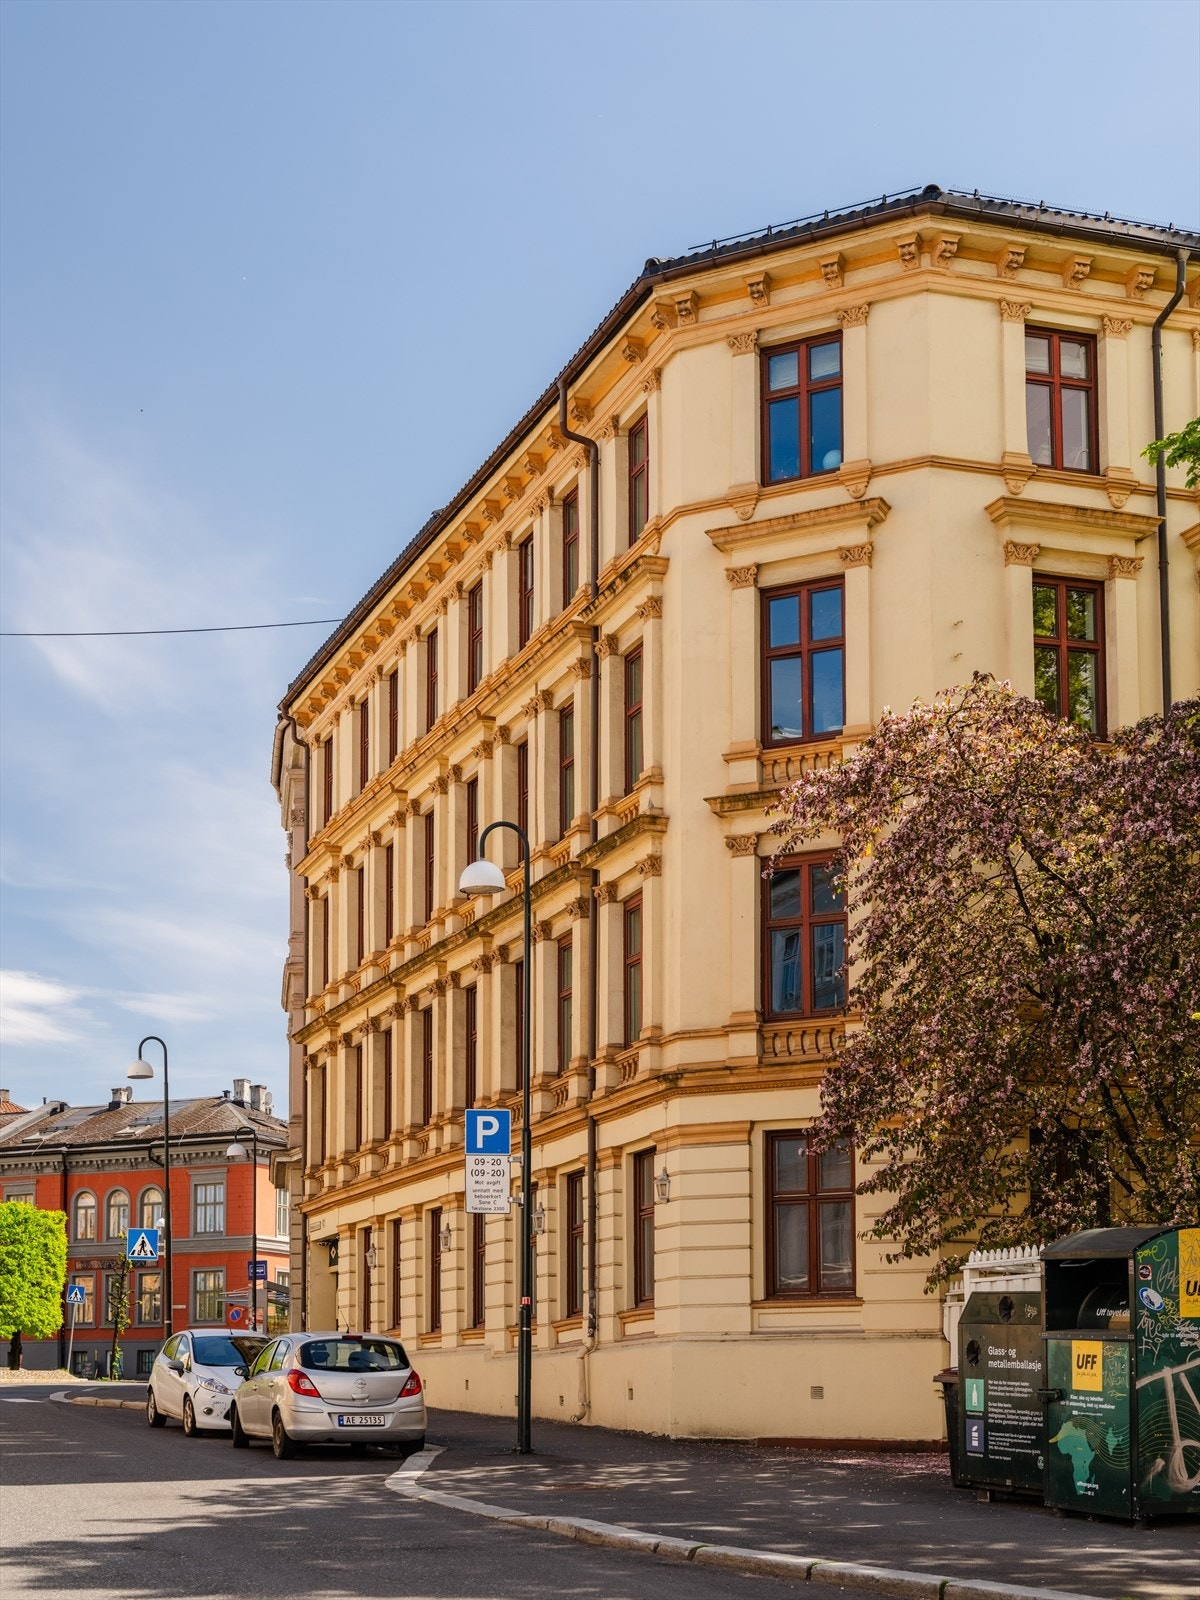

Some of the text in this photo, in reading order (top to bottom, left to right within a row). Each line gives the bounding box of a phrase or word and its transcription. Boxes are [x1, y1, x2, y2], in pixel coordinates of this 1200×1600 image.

[477, 1116, 499, 1148] P
[988, 1346, 1017, 1359] Glass- og
[988, 1359, 1042, 1372] metallemballasje
[1076, 1354, 1098, 1370] UFF
[346, 1416, 382, 1424] AE 25135
